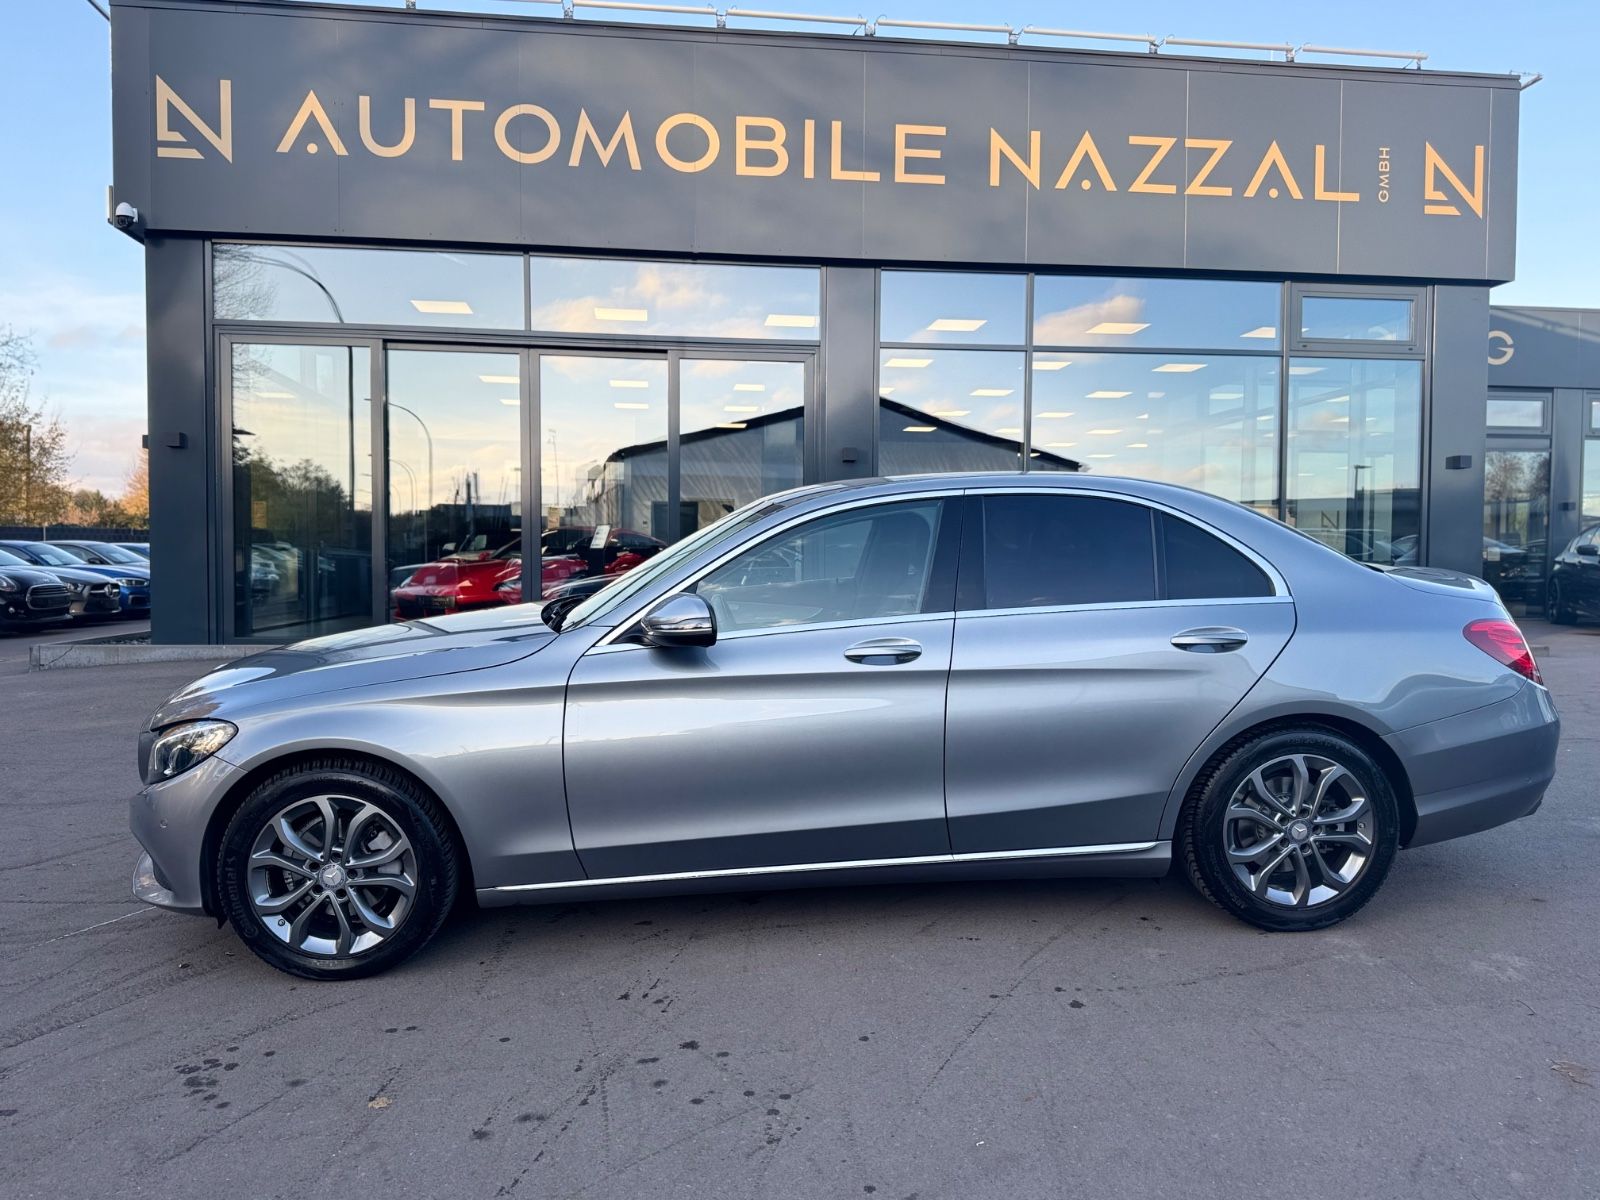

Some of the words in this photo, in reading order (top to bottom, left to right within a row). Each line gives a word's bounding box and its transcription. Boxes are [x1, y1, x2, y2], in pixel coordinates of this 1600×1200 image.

[277, 89, 949, 186] AUTOMOBILE
[987, 127, 1361, 204] NAZZAL
[1378, 147, 1391, 203] GMBH
